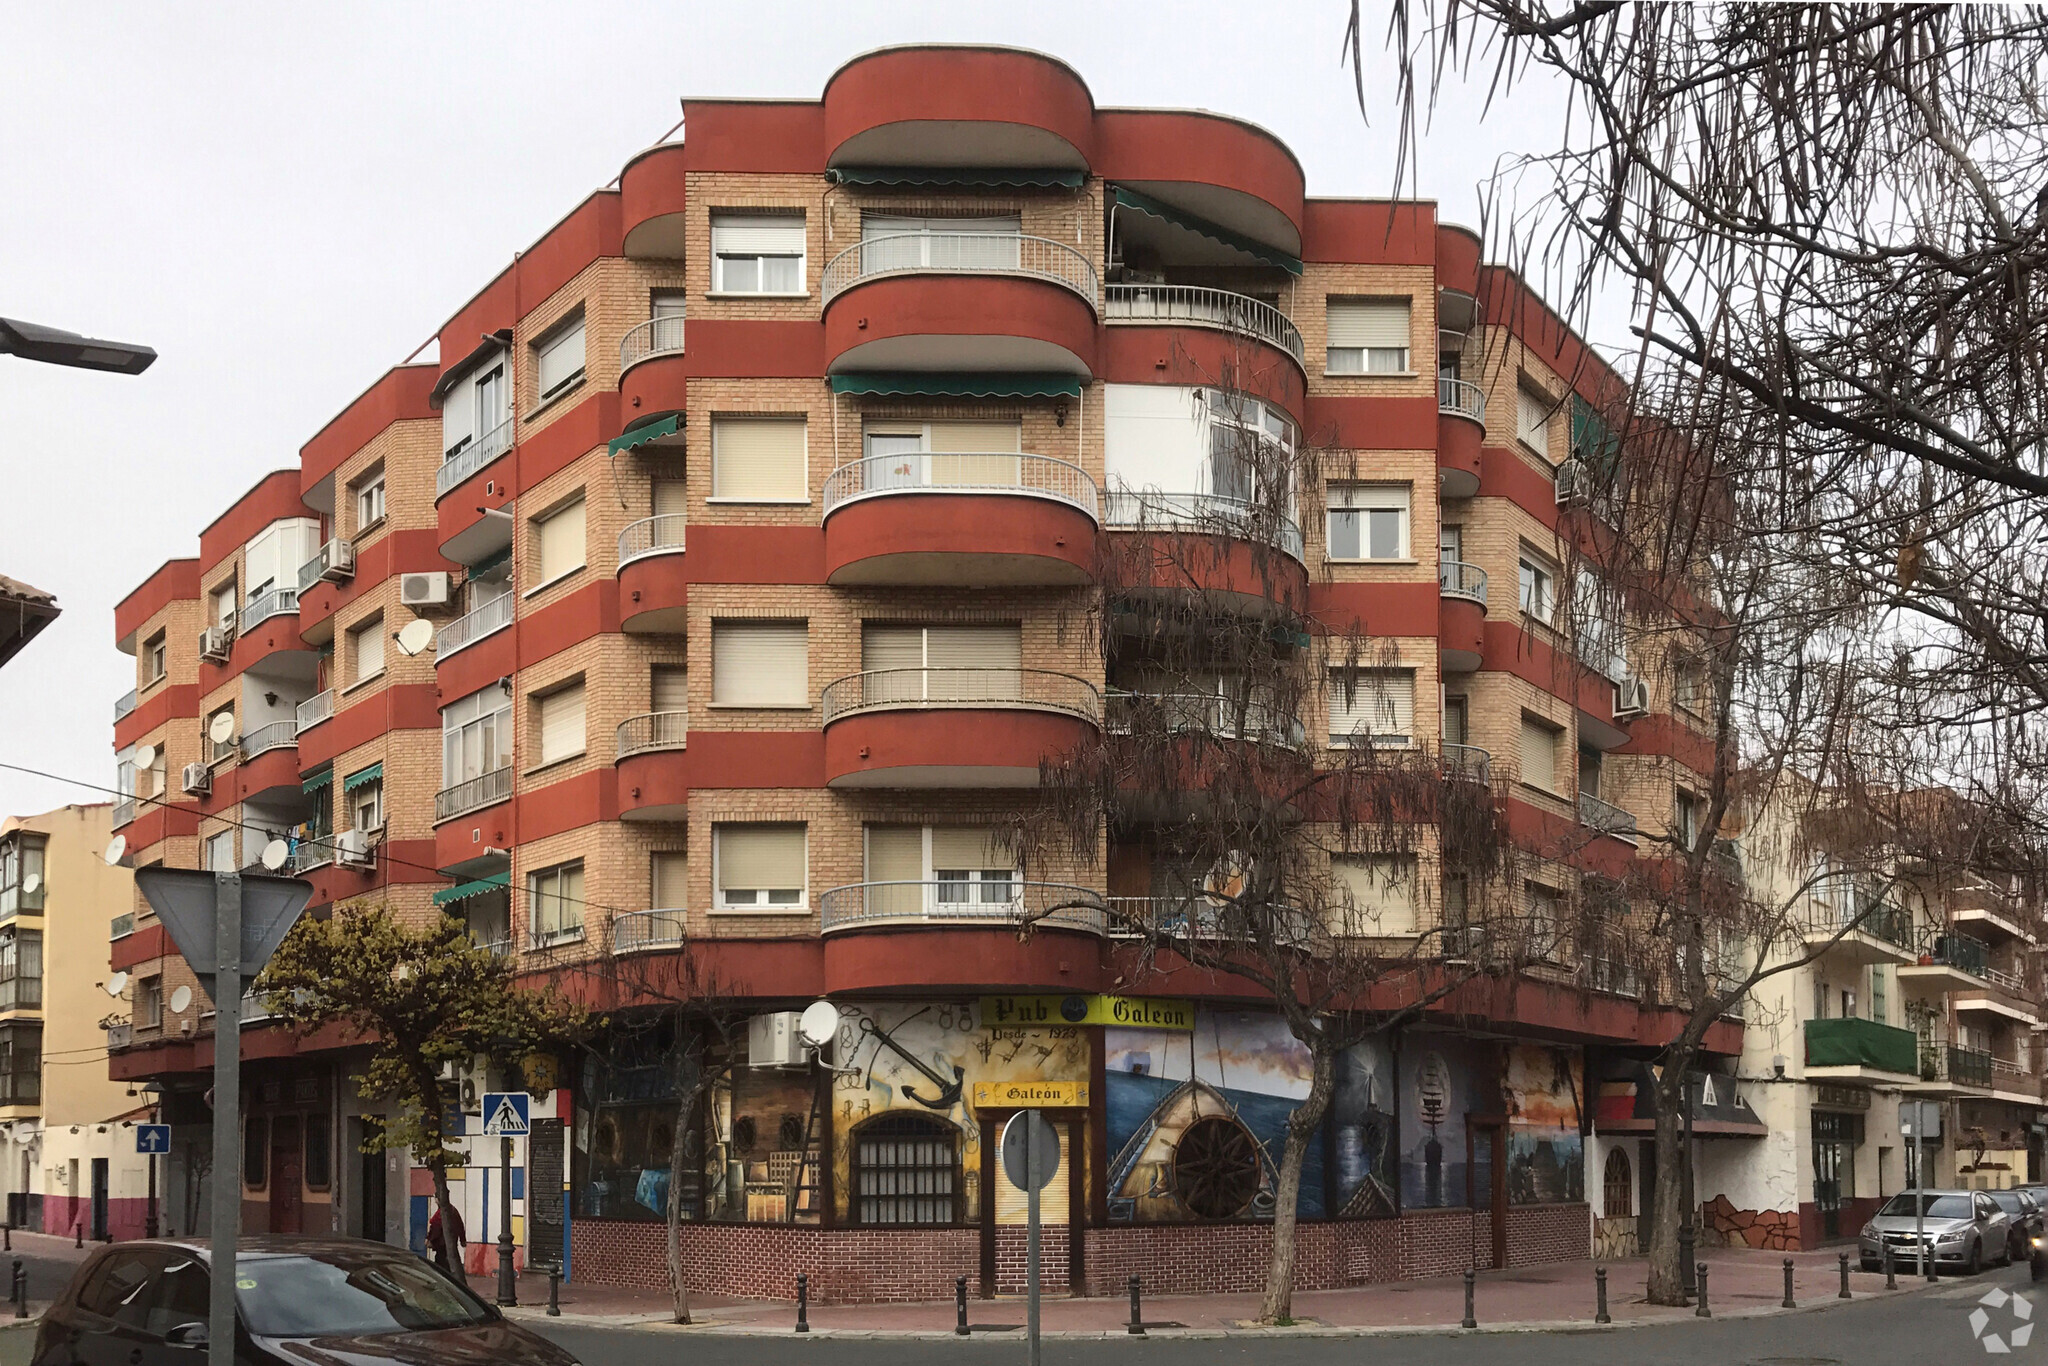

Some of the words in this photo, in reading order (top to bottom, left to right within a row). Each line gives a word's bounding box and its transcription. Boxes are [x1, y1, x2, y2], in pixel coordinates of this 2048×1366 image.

[996, 998, 1048, 1022] Pub
[1113, 1000, 1185, 1026] Galeón
[992, 1027, 1027, 1041] Desde
[1006, 1087, 1062, 1100] Galeón
